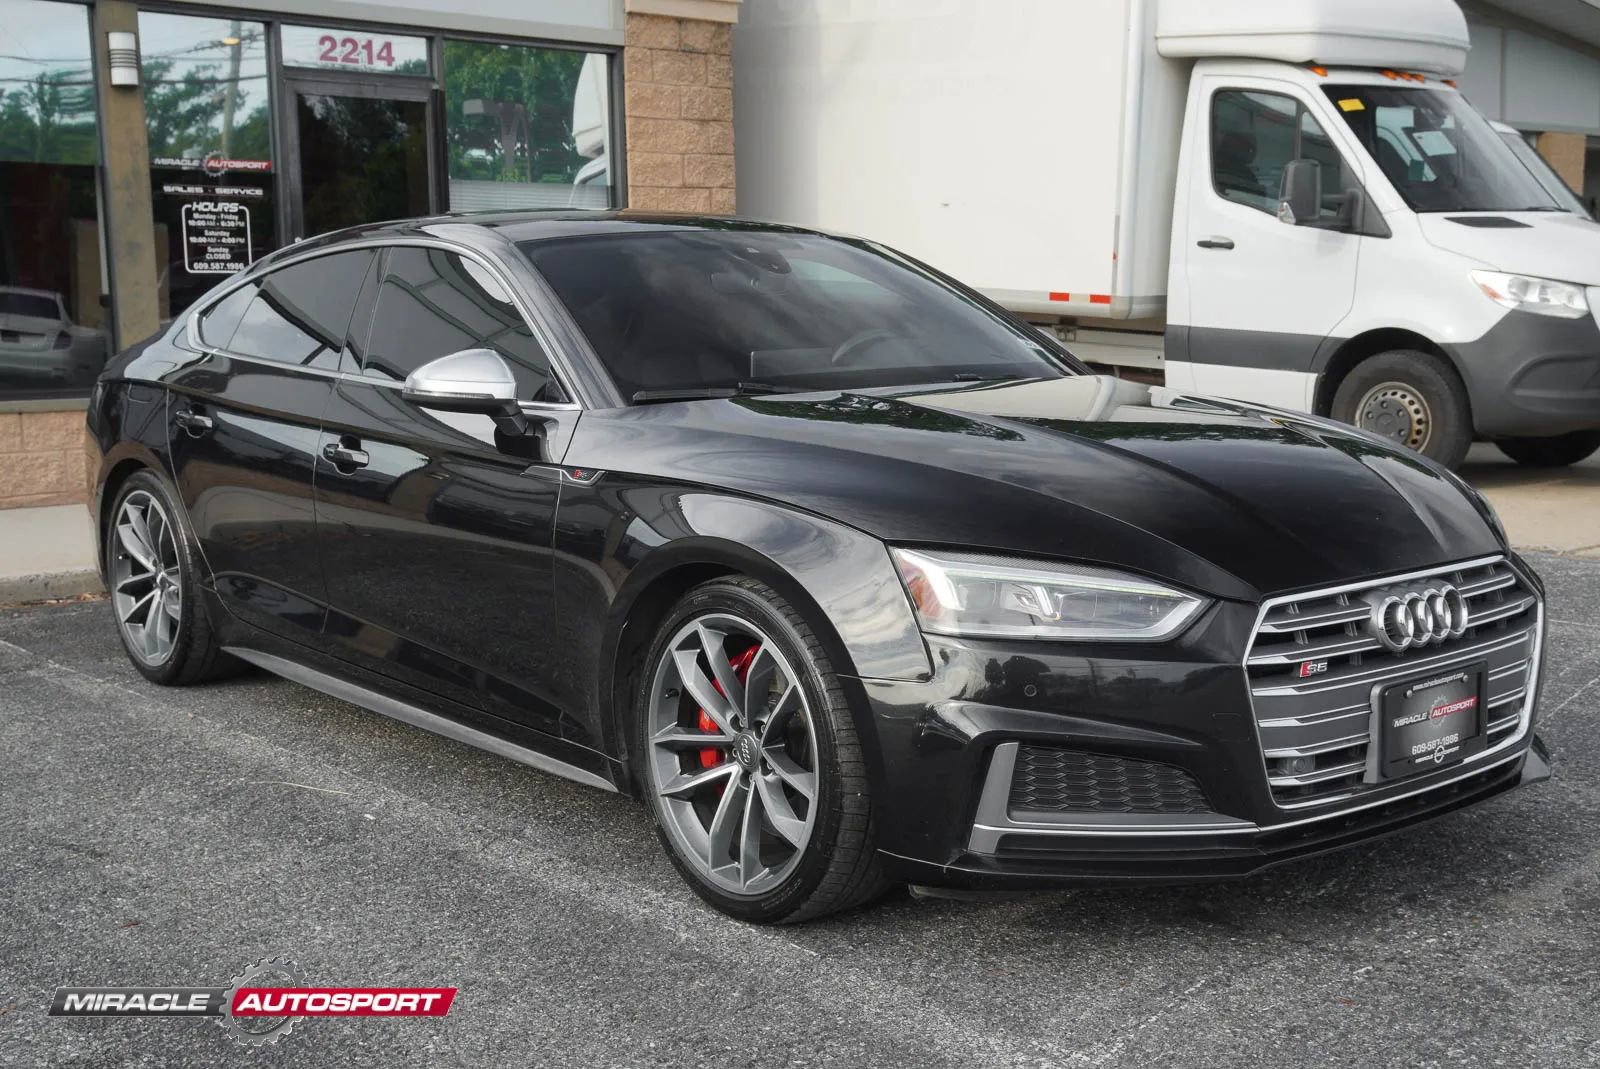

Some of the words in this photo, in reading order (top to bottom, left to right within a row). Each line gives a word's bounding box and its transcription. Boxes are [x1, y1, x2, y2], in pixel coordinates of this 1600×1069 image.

[318, 34, 395, 67] 2214
[153, 158, 200, 167] MIRACLE
[207, 160, 268, 169] AUTOSPORT
[163, 185, 204, 193] SALES
[215, 187, 263, 195] SERVICE
[192, 202, 239, 212] HOURS
[193, 212, 216, 221] Monday
[221, 213, 239, 221] Friday
[204, 230, 230, 238] Saturday
[207, 246, 229, 254] Sunday
[1393, 711, 1428, 728] MIRACLE
[1432, 698, 1474, 718] AUTOSPORT
